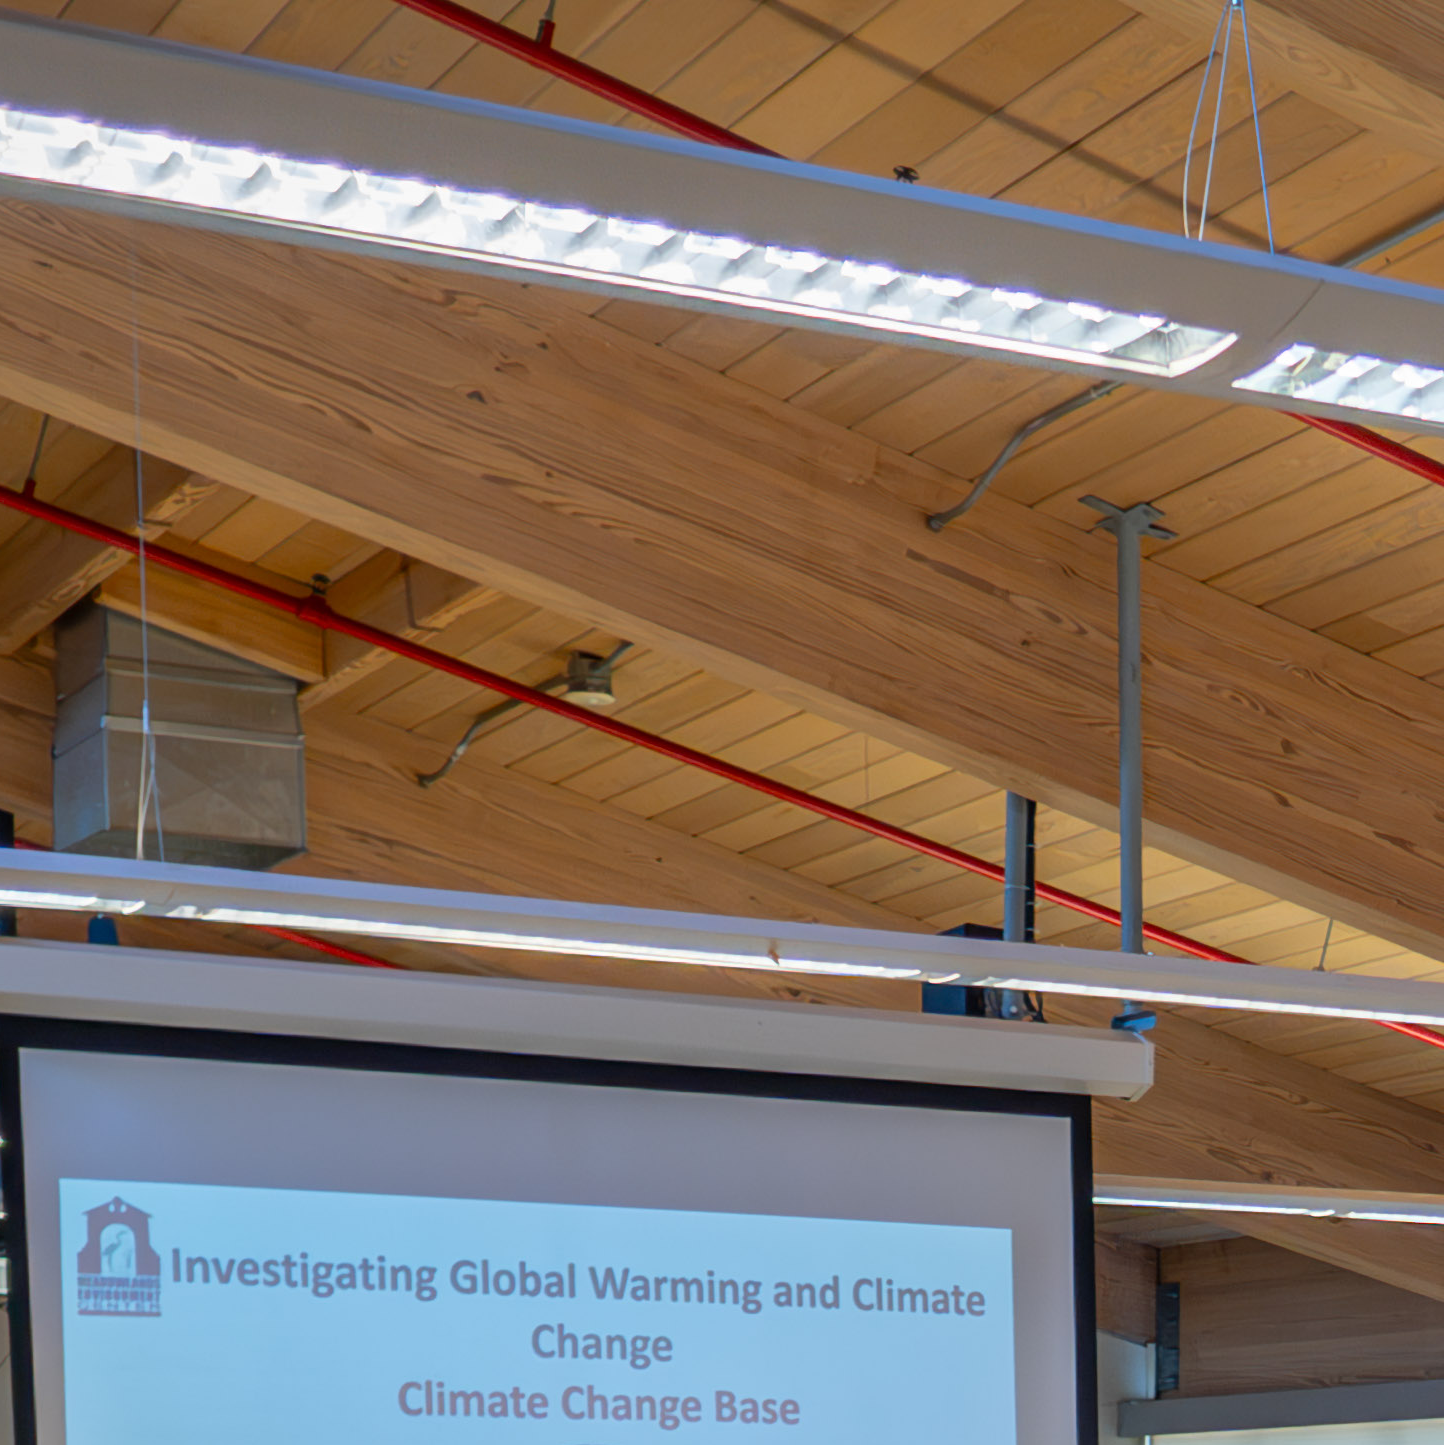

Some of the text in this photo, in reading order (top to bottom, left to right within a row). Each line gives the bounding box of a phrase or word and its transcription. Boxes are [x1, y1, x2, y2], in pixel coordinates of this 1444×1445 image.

[171, 1248, 986, 1317] Investigating Global Warming and Climate
[531, 1323, 673, 1370] Change
[398, 1380, 801, 1431] Climate Change Base
